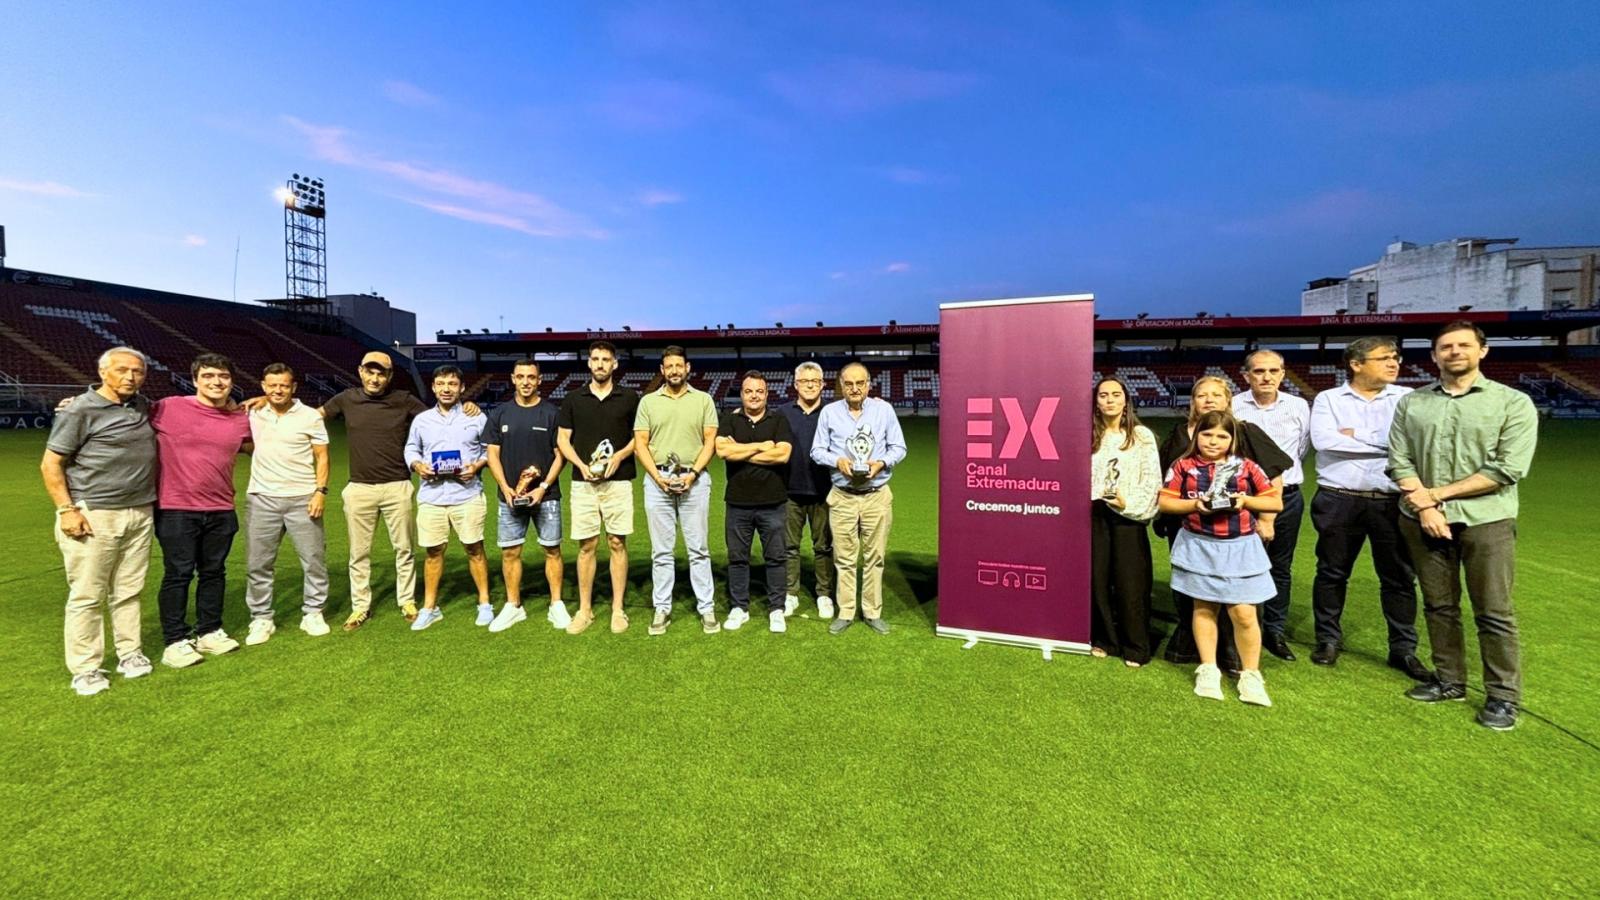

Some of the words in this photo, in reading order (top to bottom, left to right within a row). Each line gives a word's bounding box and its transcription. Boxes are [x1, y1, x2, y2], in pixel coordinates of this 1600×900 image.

[1183, 318, 1214, 327] BADAJOZ
[1320, 317, 1339, 325] JUNTA
[1342, 316, 1352, 324] DE
[1354, 315, 1403, 324] EXTREMADURA
[765, 328, 791, 336] BADAJOZ
[967, 397, 1060, 460] EX
[966, 462, 1007, 476] Canal
[966, 475, 1061, 491] Extremadura
[966, 500, 1022, 513] Crecemos
[1023, 503, 1060, 515] juntos
